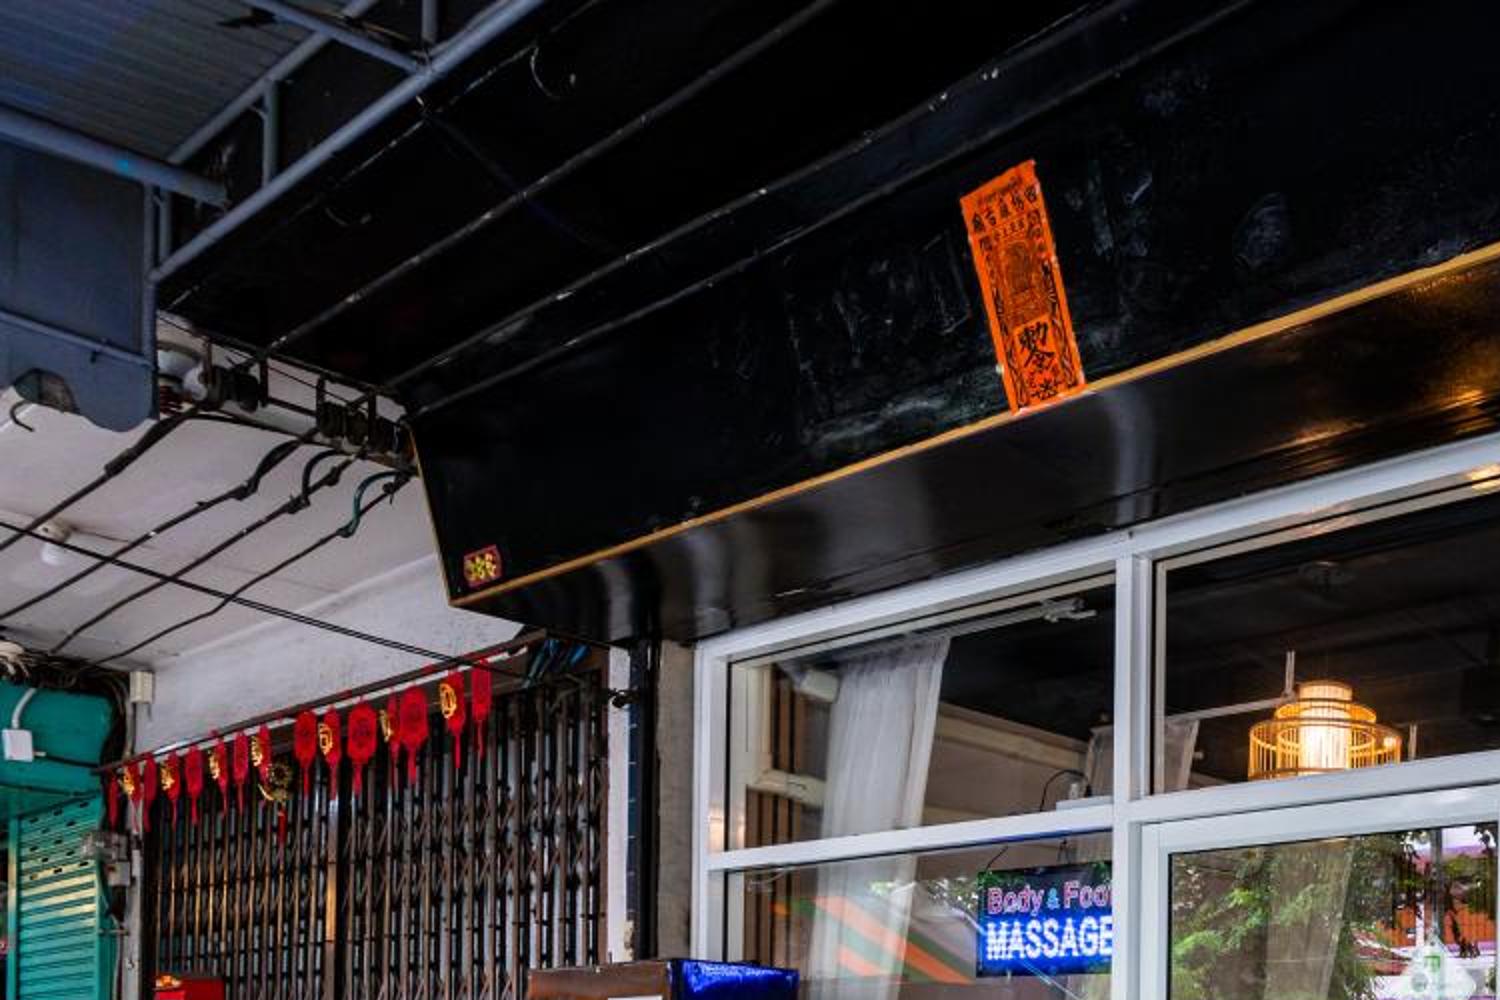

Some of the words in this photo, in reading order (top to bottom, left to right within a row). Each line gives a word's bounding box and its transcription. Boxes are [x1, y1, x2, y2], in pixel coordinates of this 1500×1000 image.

[986, 884, 1045, 917] Body
[1047, 887, 1060, 910] &
[1063, 880, 1112, 909] Foo
[986, 915, 1112, 960] MASSAGE
